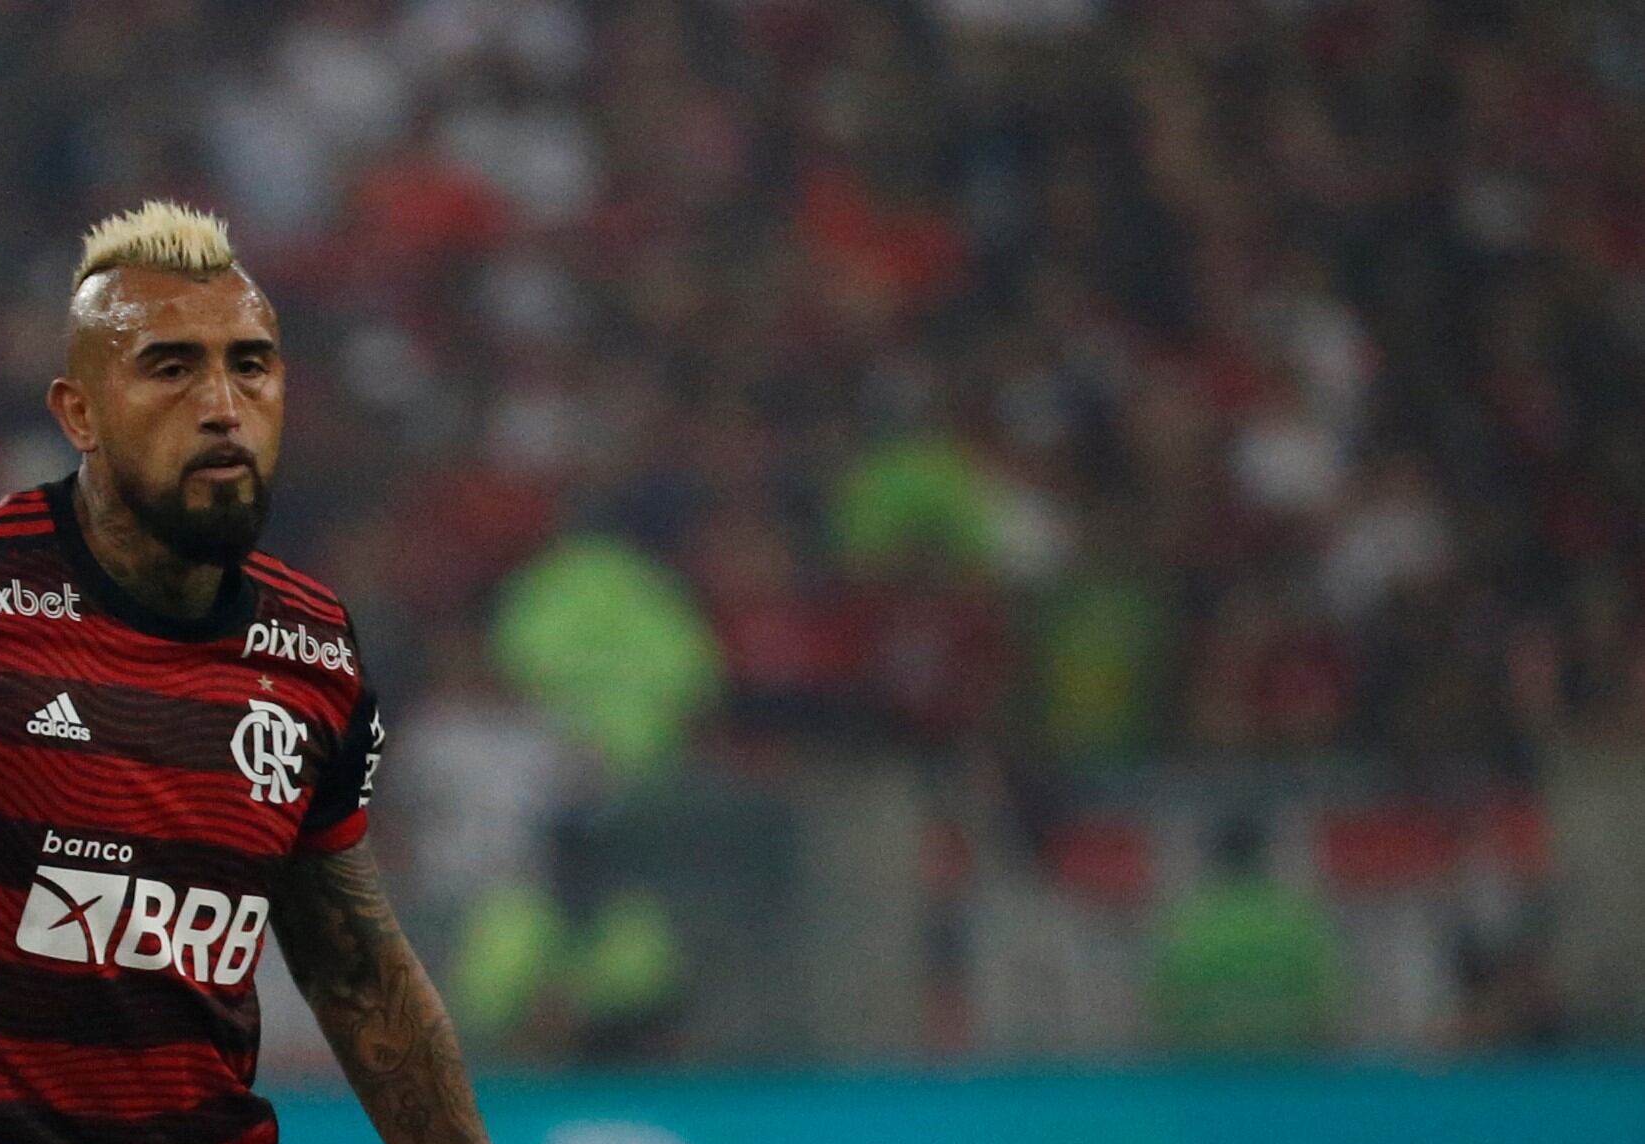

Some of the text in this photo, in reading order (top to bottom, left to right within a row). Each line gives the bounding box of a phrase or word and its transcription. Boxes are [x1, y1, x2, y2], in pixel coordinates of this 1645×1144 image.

[241, 618, 355, 677] pixbet
[26, 718, 92, 741] adidas
[41, 829, 134, 863] banco
[113, 877, 270, 986] BRB
